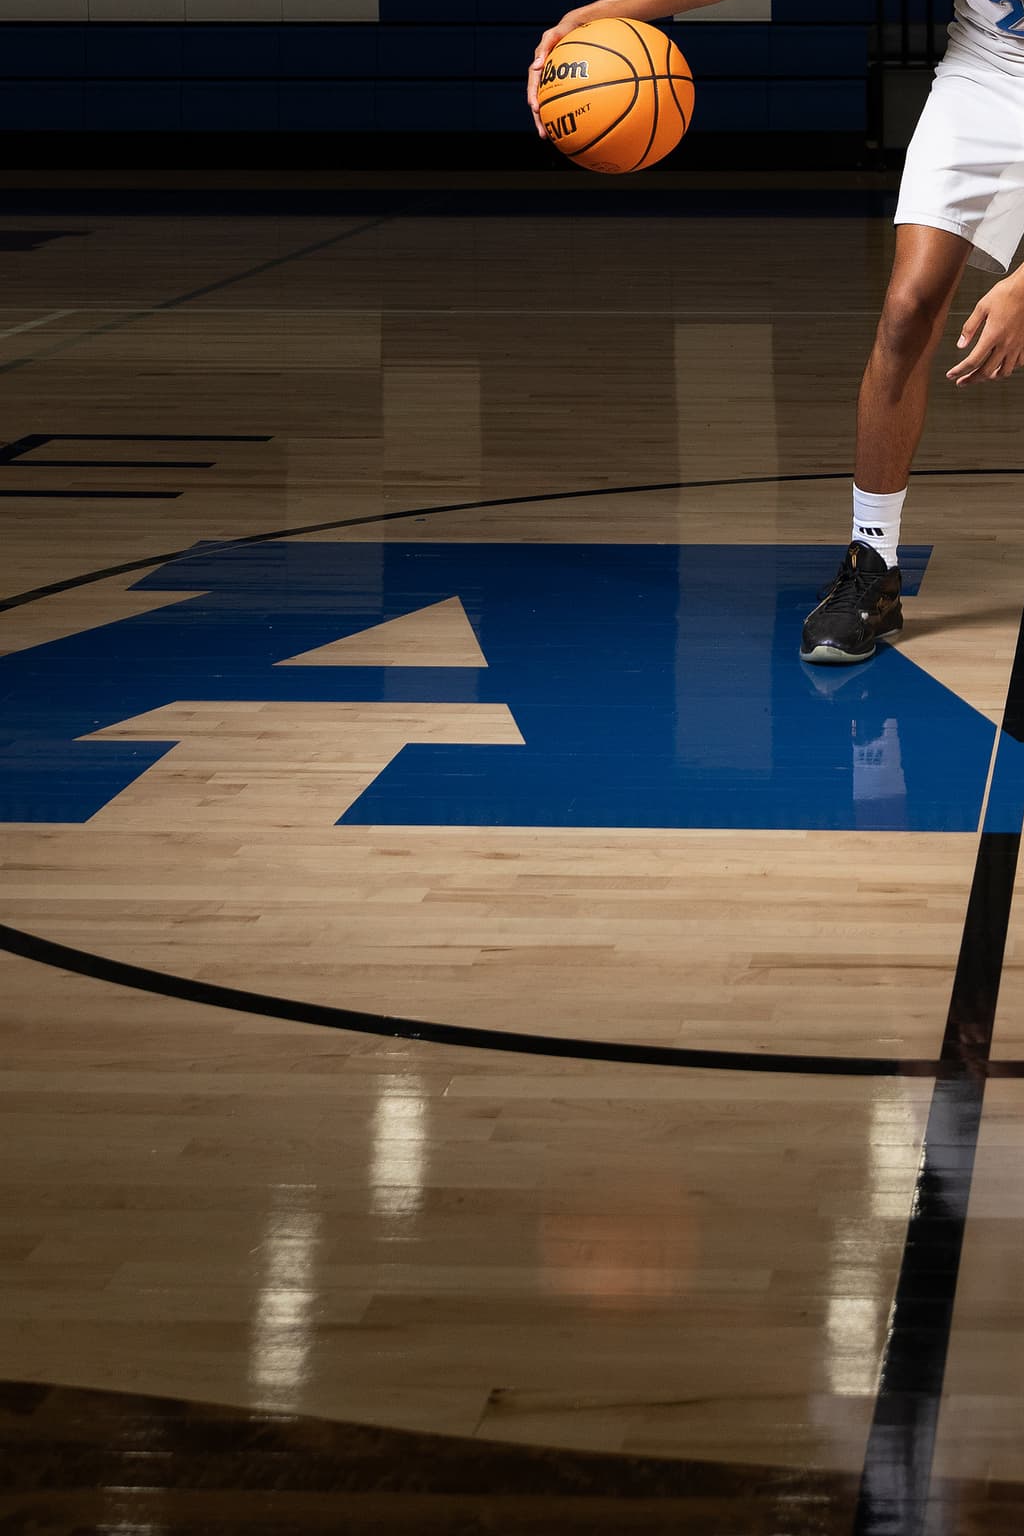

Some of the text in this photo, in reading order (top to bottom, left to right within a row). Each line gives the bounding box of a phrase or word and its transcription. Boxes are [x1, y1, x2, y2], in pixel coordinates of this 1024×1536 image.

[540, 59, 589, 87] ilson
[545, 102, 592, 141] EVO NXT
